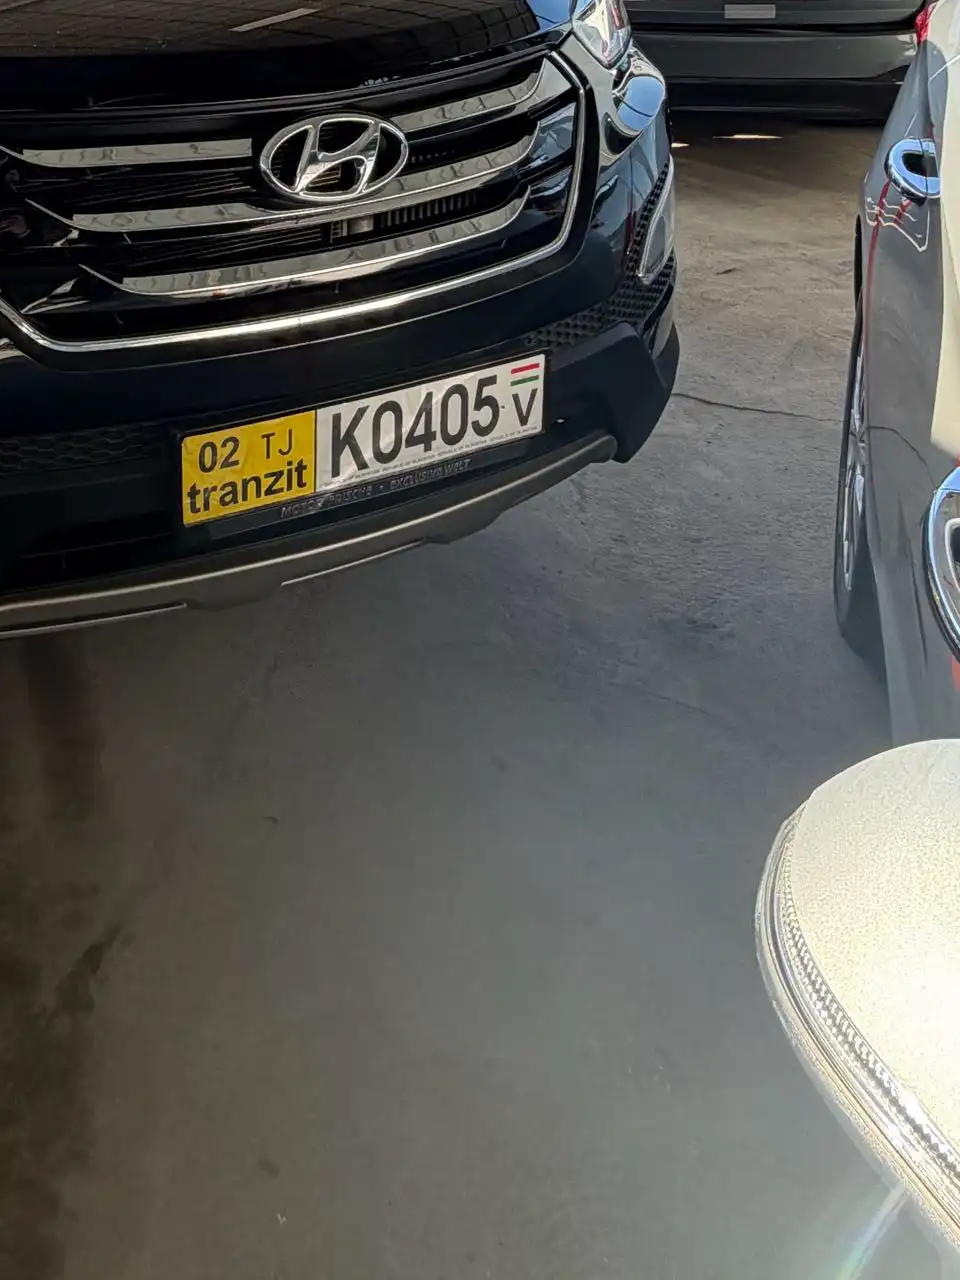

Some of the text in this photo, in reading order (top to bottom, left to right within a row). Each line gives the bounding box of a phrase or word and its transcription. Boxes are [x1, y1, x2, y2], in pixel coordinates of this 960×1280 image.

[331, 374, 500, 479] K0405
[511, 387, 539, 427] V
[198, 428, 293, 473] 02 TJ
[187, 458, 308, 514] tranzit
